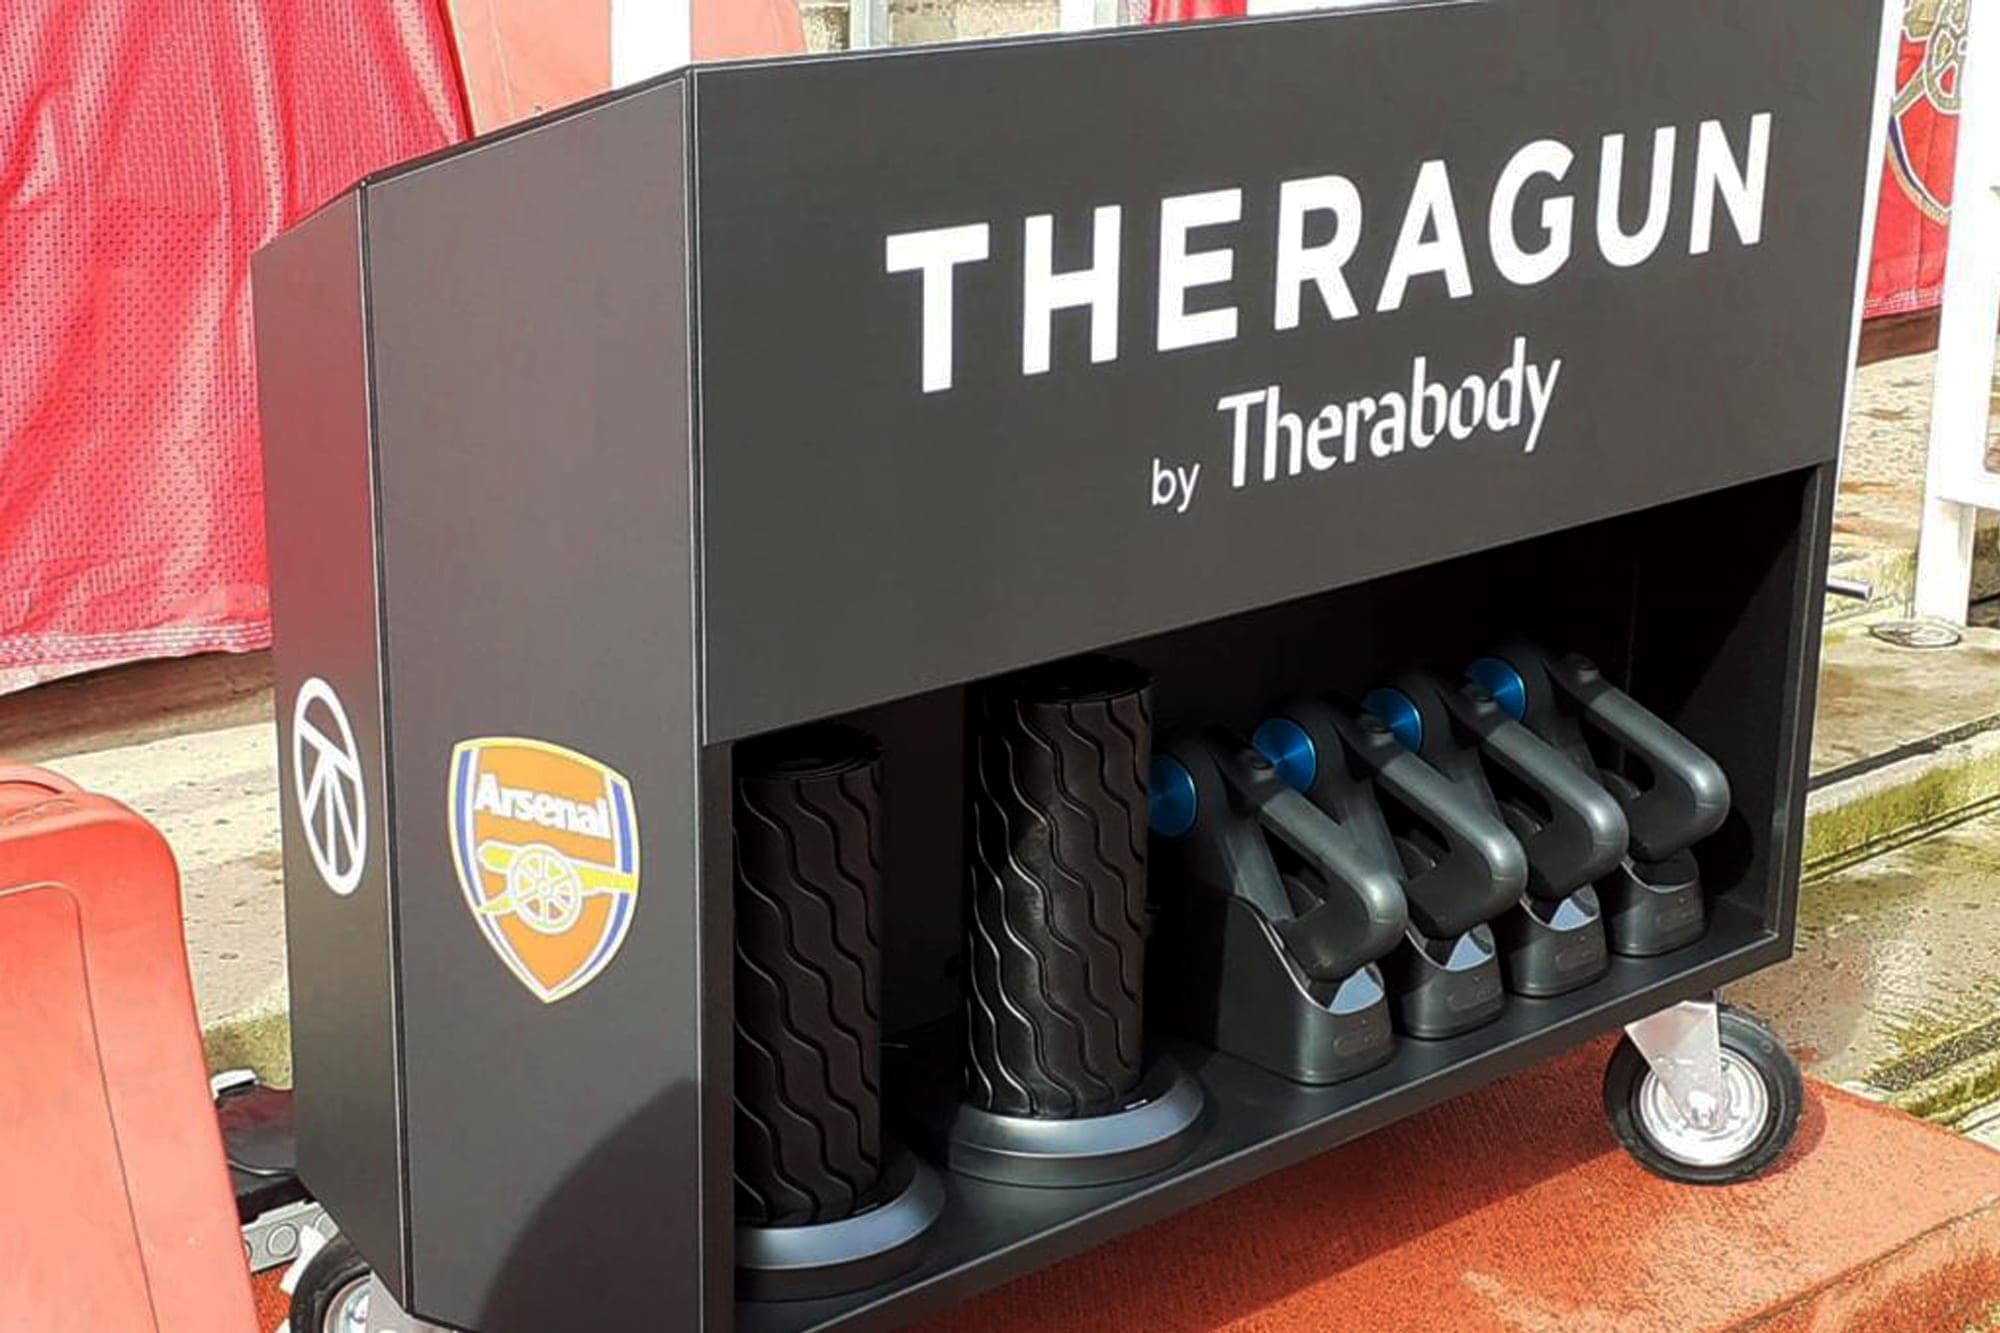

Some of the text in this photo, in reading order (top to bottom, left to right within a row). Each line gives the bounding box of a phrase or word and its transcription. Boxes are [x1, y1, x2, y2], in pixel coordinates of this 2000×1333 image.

[886, 112, 1771, 393] THERAGUN
[1151, 336, 1561, 513] by Therabody
[473, 773, 612, 839] Arsenal
